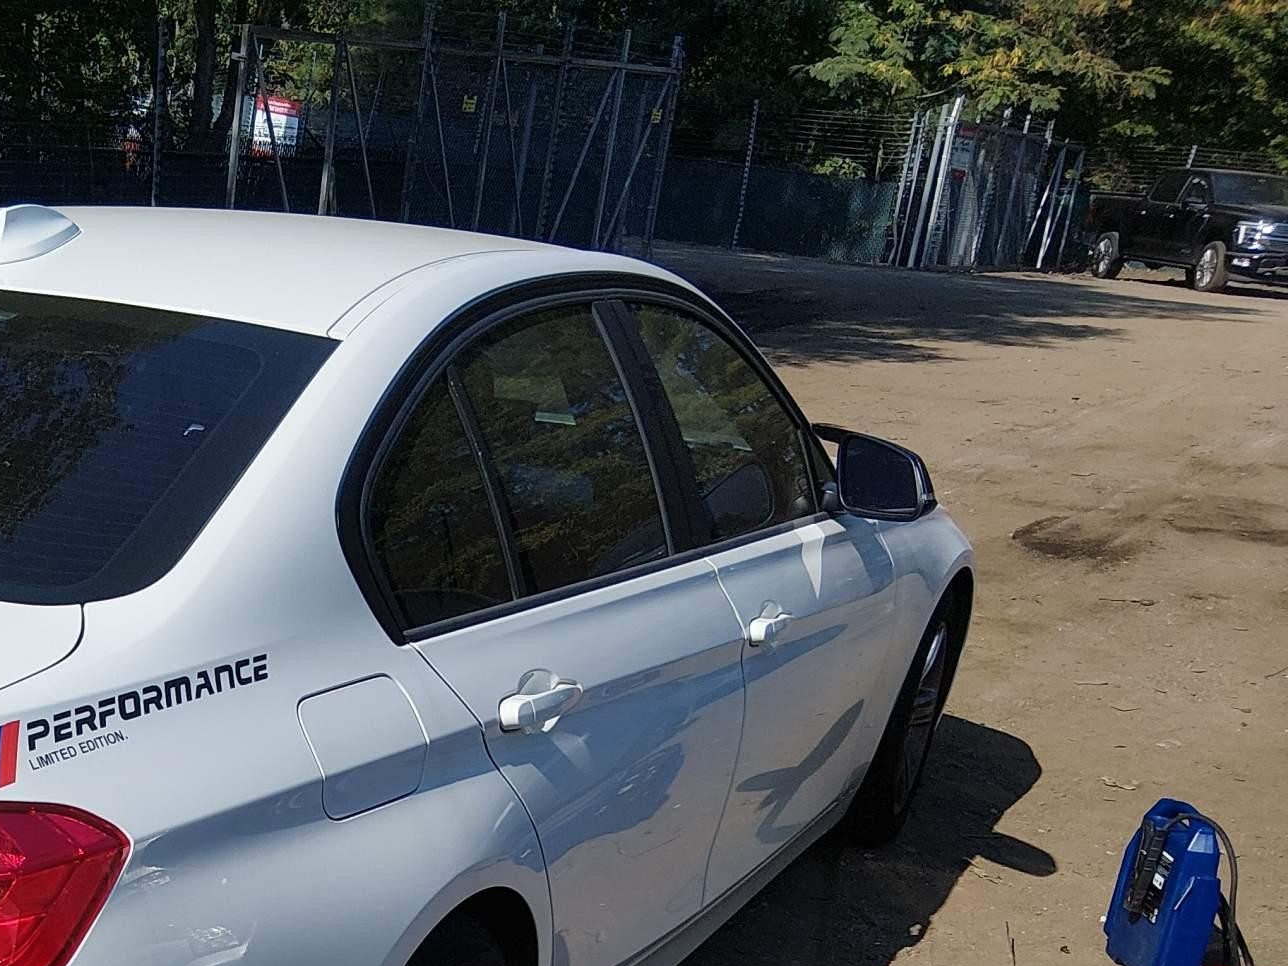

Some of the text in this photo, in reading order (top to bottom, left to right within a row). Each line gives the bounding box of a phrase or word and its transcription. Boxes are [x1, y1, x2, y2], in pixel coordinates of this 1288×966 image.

[26, 653, 269, 752] PERFORMANCE
[28, 730, 129, 771] LIMITED EDITION.
